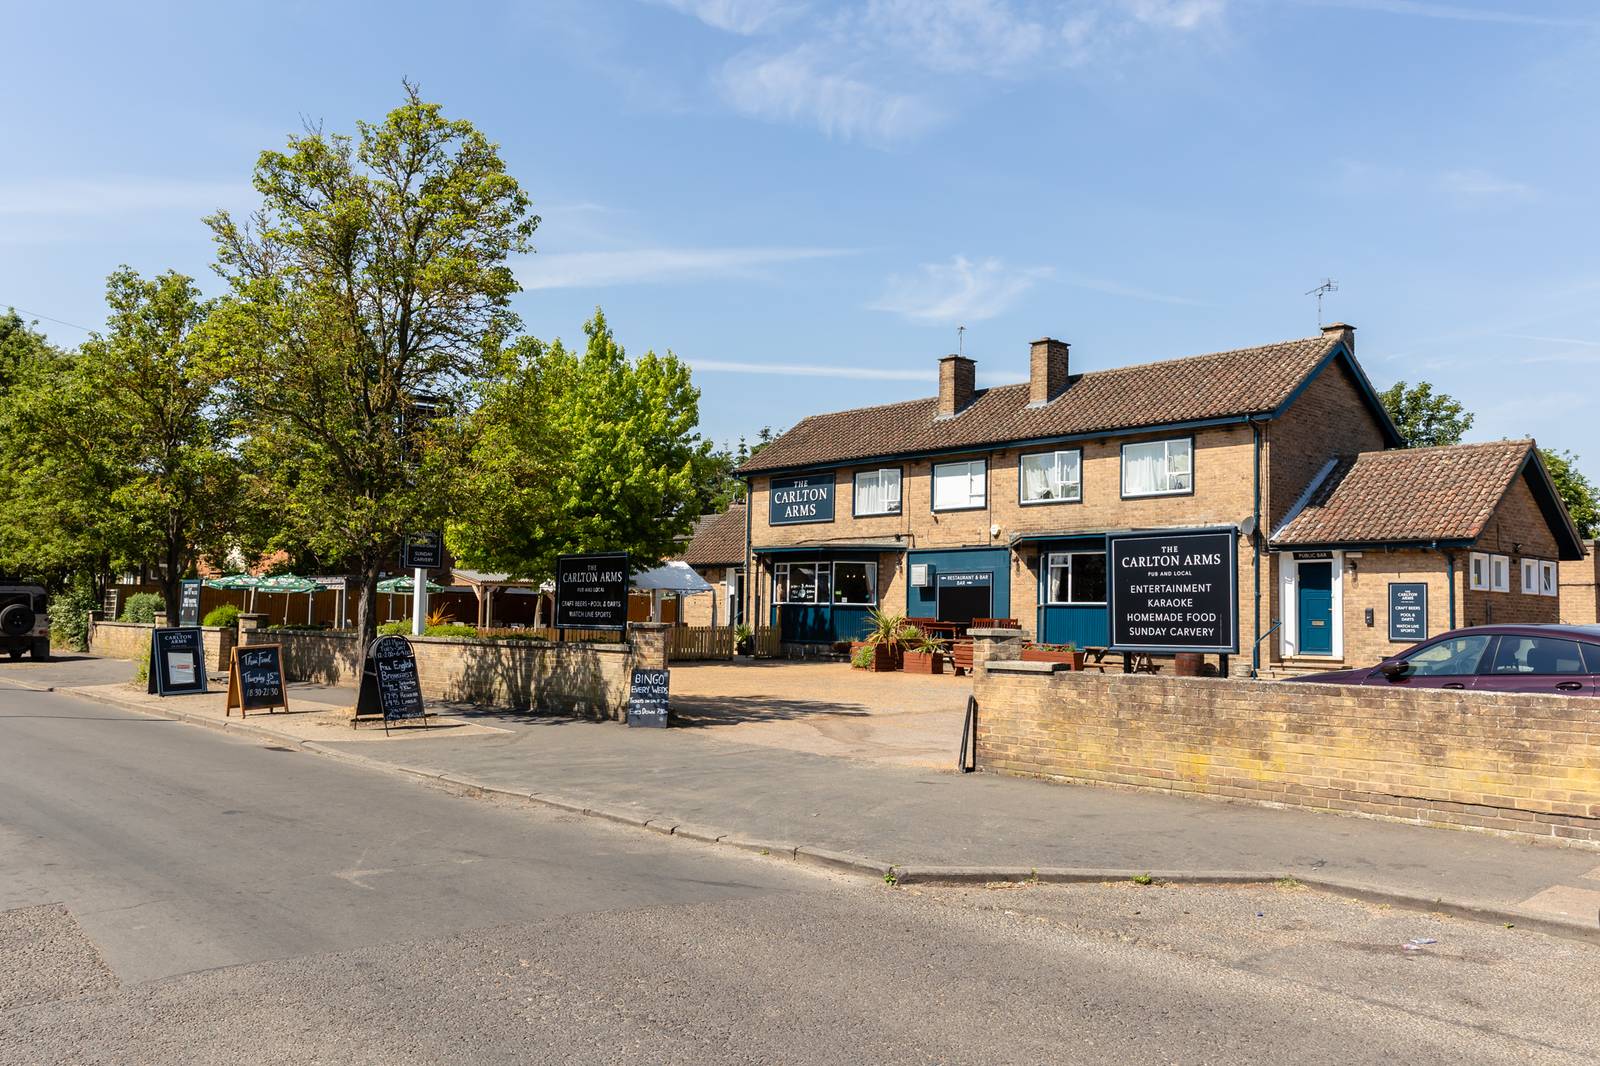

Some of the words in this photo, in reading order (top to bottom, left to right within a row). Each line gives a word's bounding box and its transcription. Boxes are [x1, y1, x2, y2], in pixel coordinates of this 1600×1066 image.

[794, 480, 808, 488] THE
[774, 488, 828, 504] CARLTON
[785, 504, 816, 518] ARMS
[1122, 555, 1180, 568] CARLTON
[1184, 553, 1221, 566] ARMS
[562, 572, 598, 583] CARLTON
[600, 571, 623, 582] ARMS
[1130, 583, 1212, 594] ENTERTAINMENT
[1147, 598, 1193, 607] KARAOKE
[1127, 613, 1183, 622] HOMEMADE
[1187, 613, 1217, 622] FOOD
[1129, 627, 1167, 636] SUNDAY
[1170, 627, 1215, 637] CARVERY
[635, 673, 665, 685] BINGO
[631, 685, 650, 694] EVERY
[651, 685, 669, 694] WEDS
